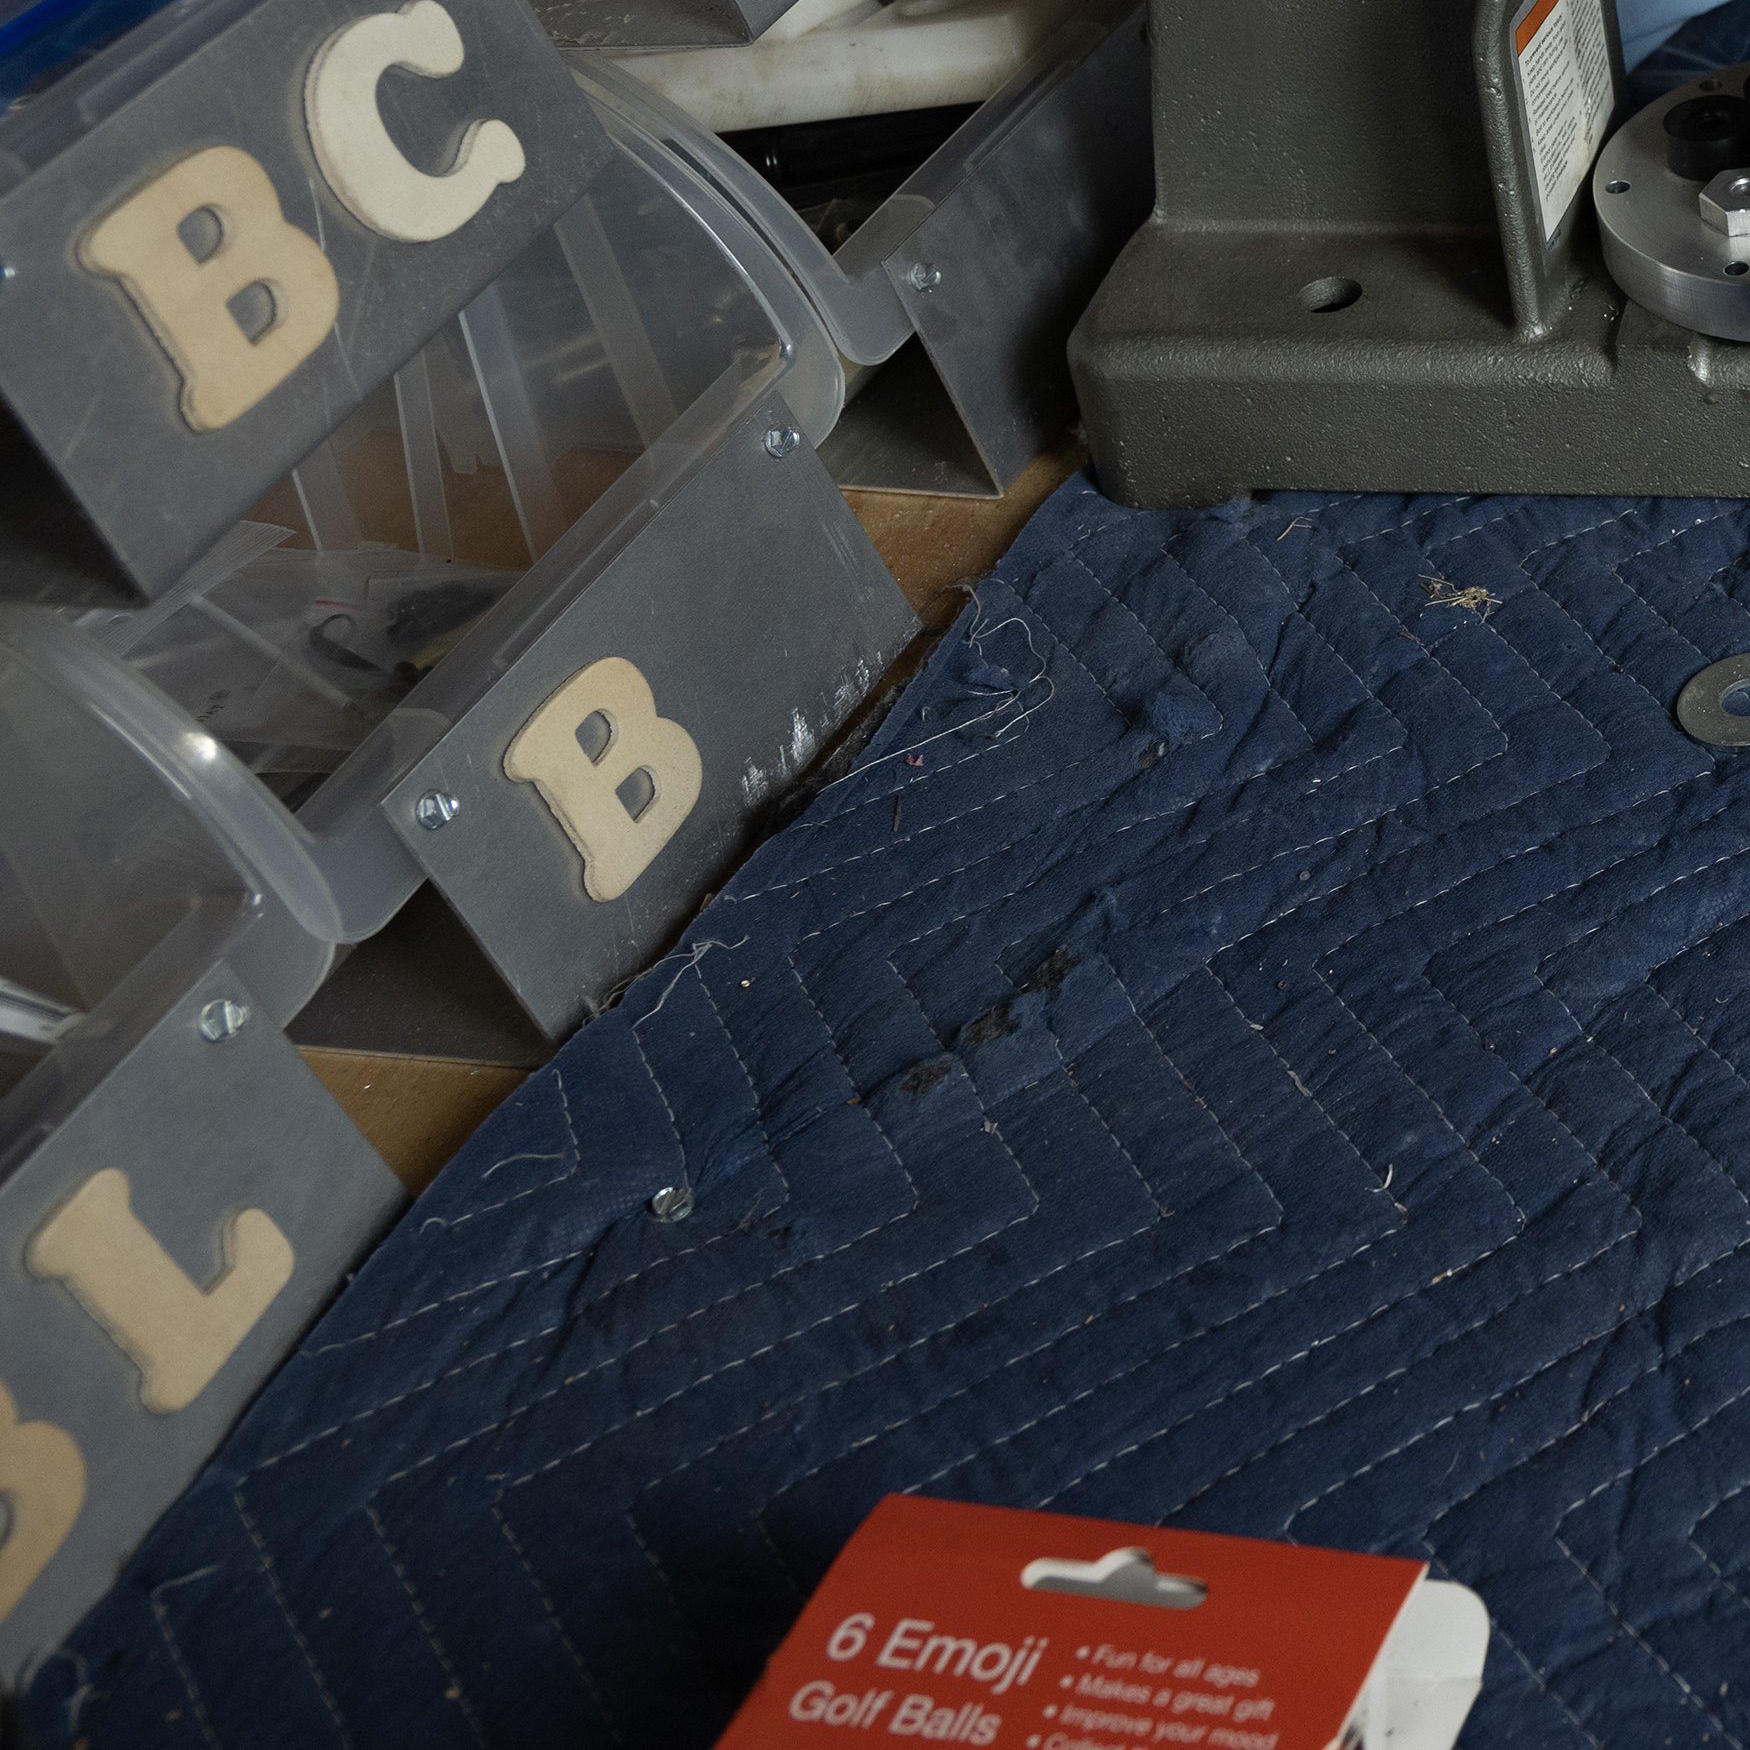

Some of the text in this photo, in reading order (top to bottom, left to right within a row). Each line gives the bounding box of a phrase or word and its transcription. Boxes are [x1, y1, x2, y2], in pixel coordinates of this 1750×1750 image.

[503, 656, 702, 904] B
[826, 1612, 1049, 1696] 6 Emoji
[1090, 1643, 1138, 1670] Fun
[1137, 1650, 1174, 1675] for
[788, 1679, 1002, 1747] Golf Balls
